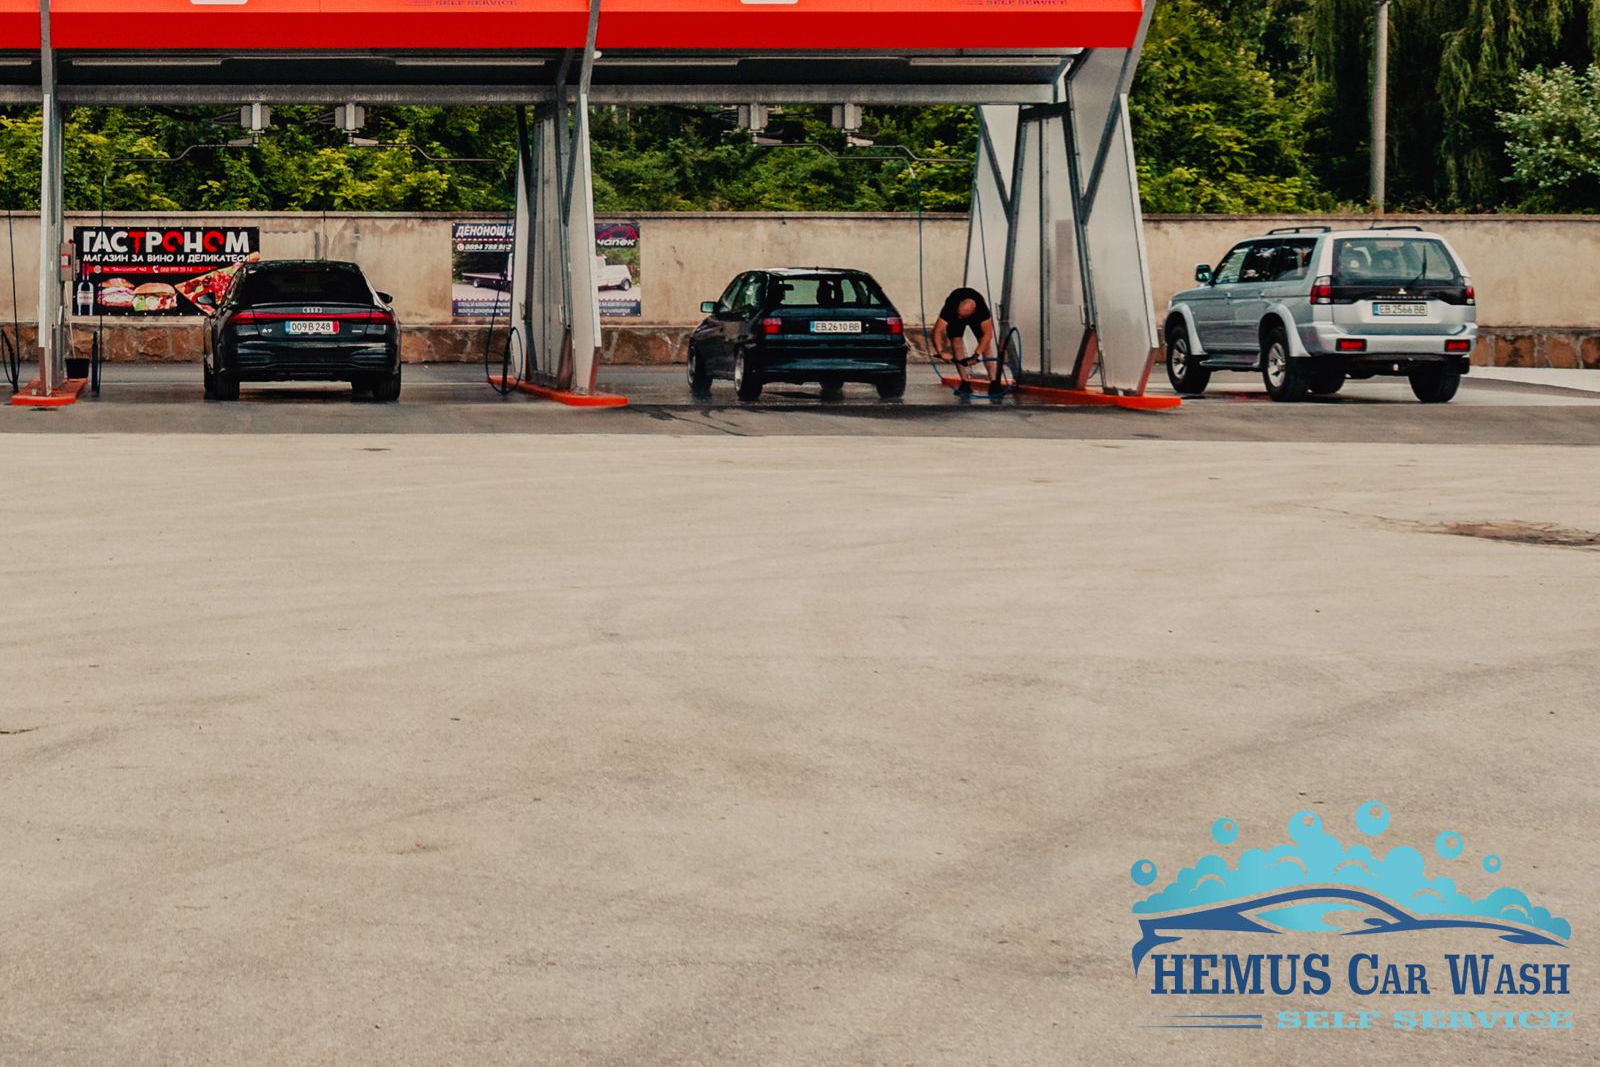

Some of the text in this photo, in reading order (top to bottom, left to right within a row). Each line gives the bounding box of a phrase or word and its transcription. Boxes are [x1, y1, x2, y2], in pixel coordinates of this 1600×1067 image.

[455, 225, 514, 237] ДЕНОНОЩН
[82, 231, 250, 254] ГАСТРОНОМ
[82, 254, 250, 263] МАГАЗИН ЗА ВИНО И ДЕЛИКАТЕСИ
